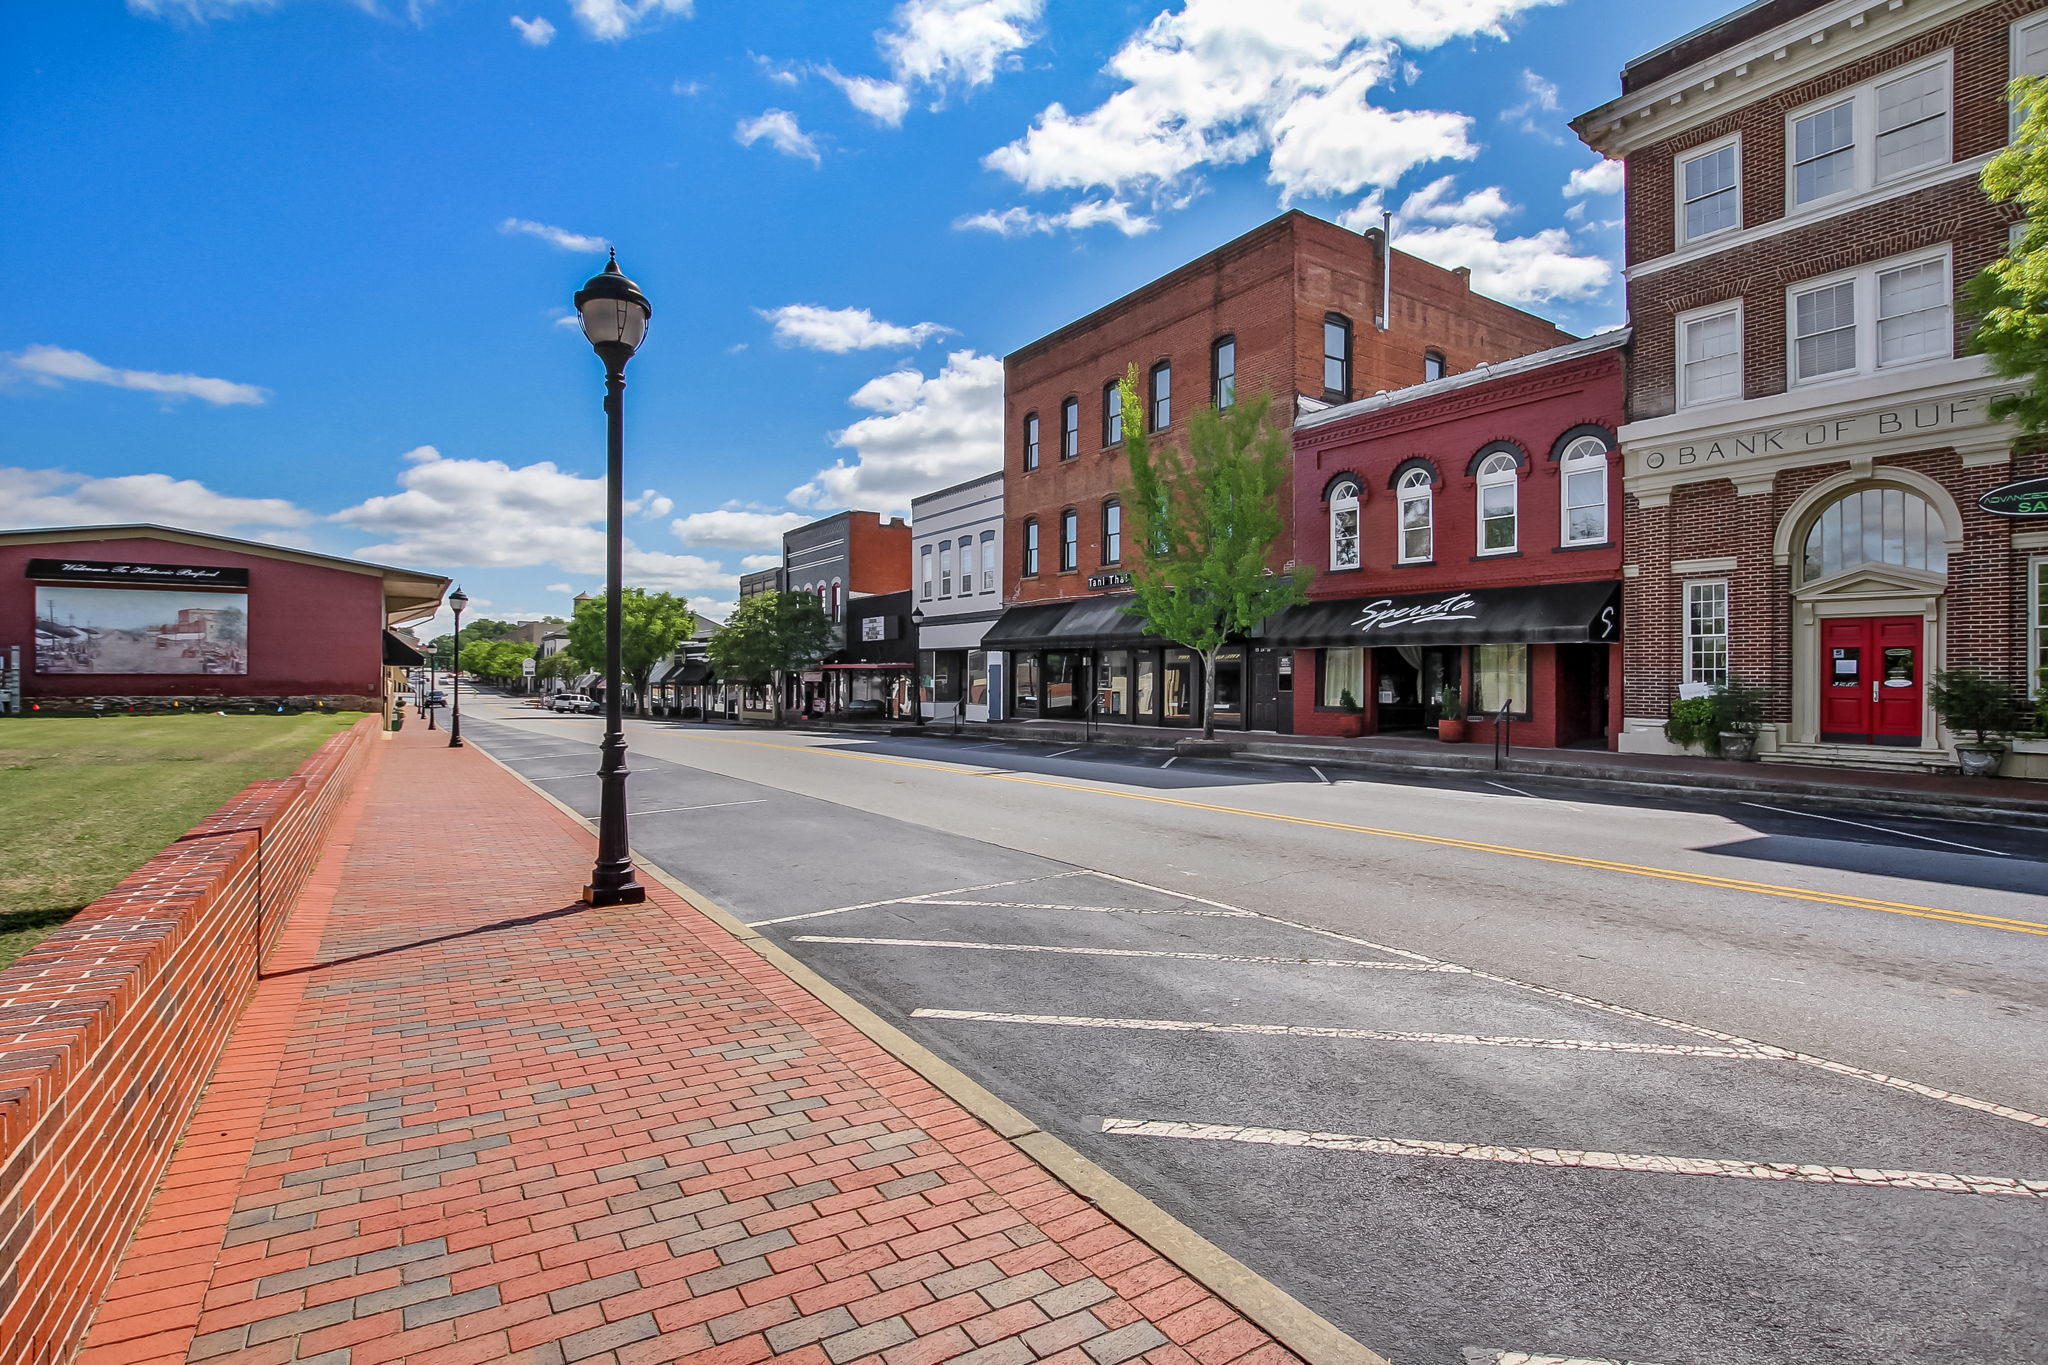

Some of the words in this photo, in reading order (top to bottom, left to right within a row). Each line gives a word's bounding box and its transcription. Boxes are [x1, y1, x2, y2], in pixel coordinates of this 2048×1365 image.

[1679, 429, 1784, 465] BANK
[1805, 419, 1856, 445] OF
[1088, 576, 1105, 588] Tani
[1351, 593, 1477, 632] Sperata
